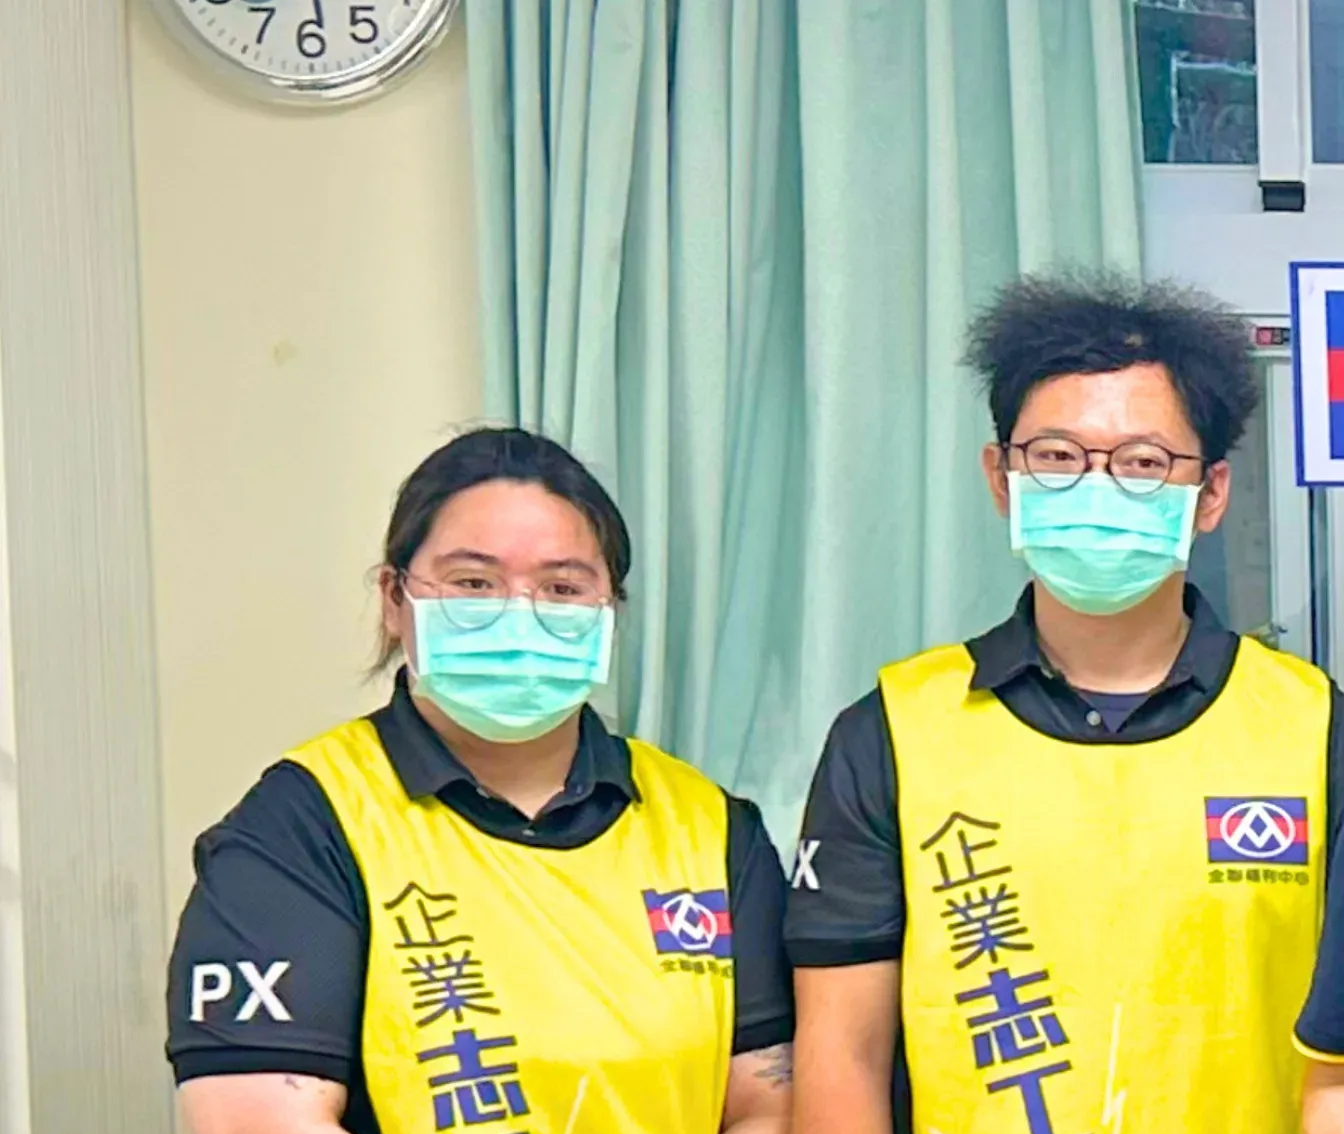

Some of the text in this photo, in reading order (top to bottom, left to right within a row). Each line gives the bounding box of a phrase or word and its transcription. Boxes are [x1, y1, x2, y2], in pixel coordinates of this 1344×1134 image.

[248, 7, 276, 45] 7
[296, 19, 326, 58] 6
[348, 5, 378, 43] 5
[189, 960, 295, 1022] PX
